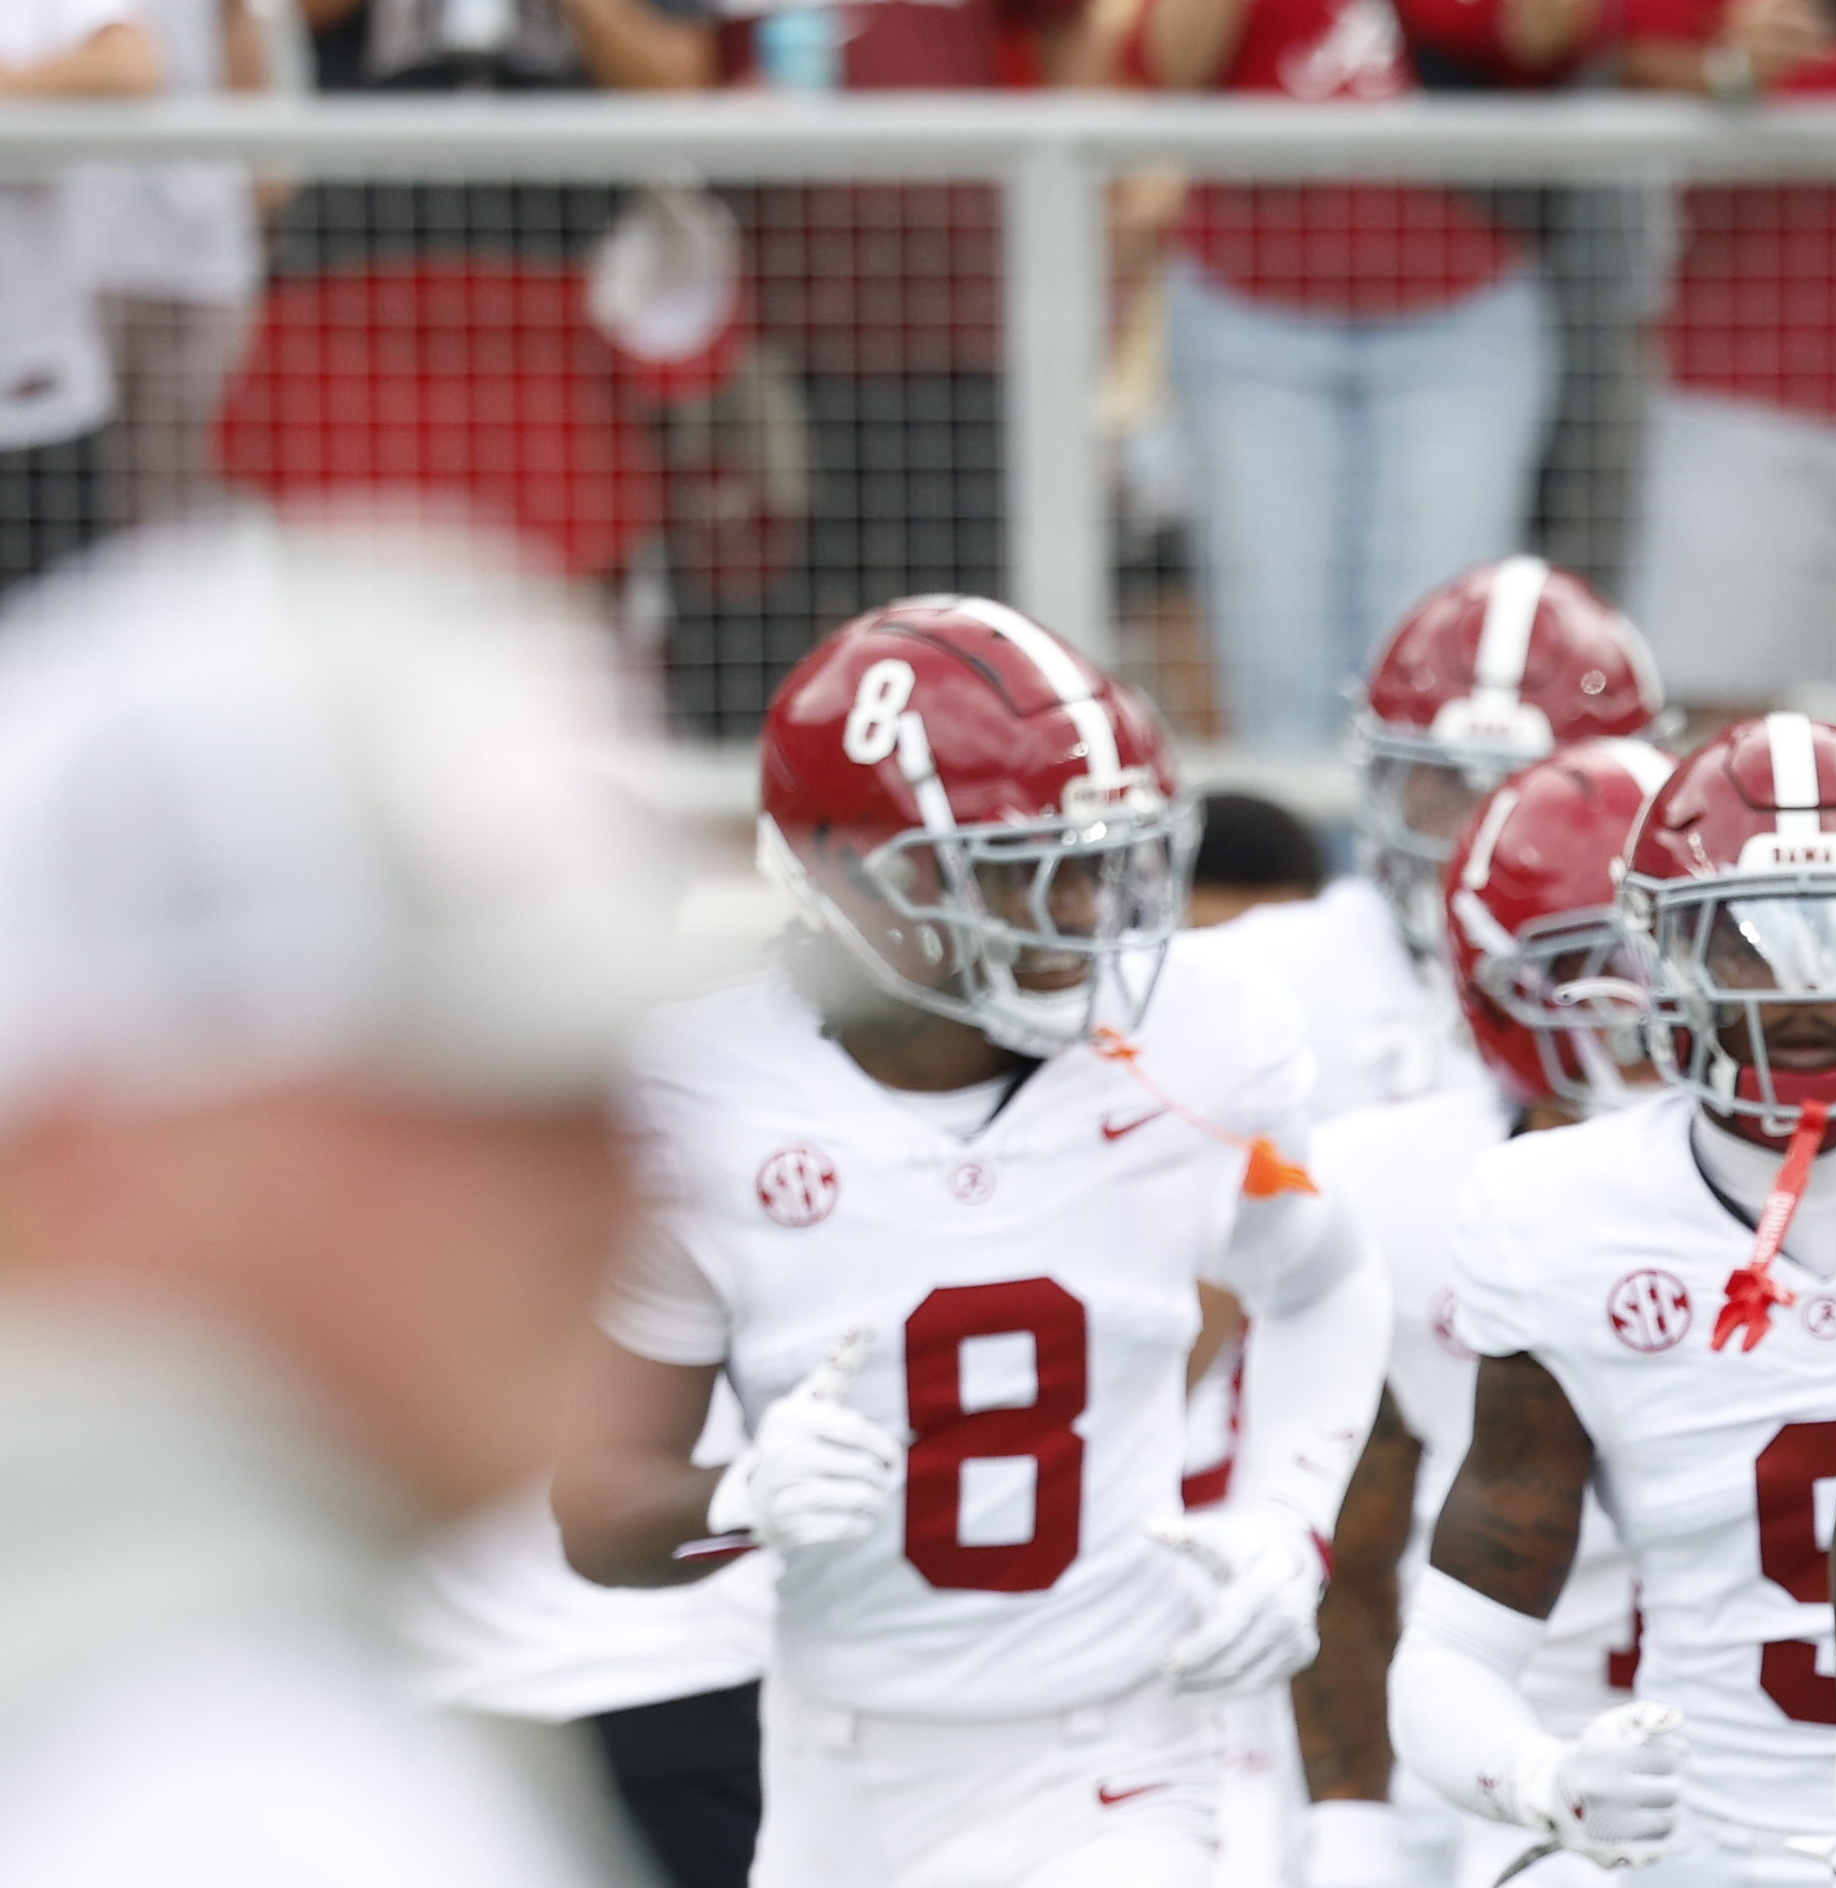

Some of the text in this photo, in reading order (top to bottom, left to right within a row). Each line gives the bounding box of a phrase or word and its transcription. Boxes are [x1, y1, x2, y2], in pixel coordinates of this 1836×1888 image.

[843, 657, 915, 765] 8
[1609, 1270, 1690, 1352] SEC
[903, 1276, 1087, 1593] 8
